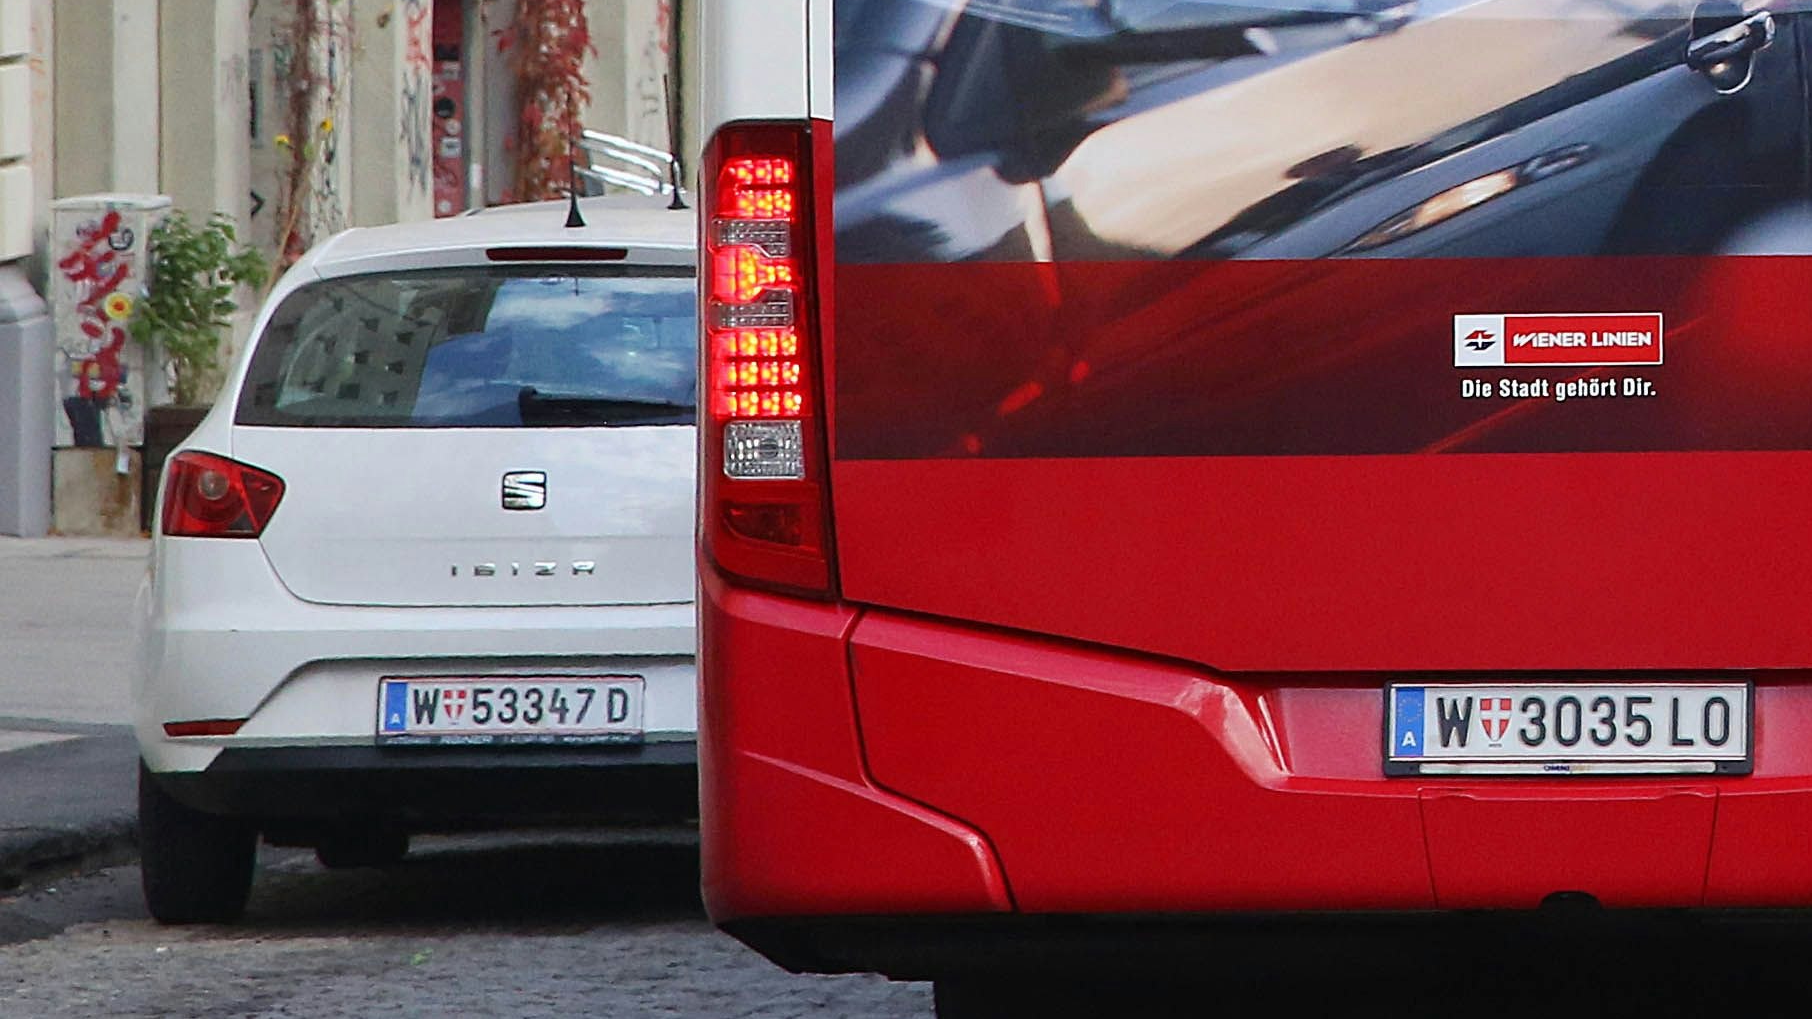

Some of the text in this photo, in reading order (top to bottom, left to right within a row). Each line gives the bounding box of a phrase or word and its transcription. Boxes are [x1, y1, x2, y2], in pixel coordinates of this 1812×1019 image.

[1513, 331, 1652, 348] WIENER LINIEN
[1462, 377, 1657, 401] Die Stadt gehört Dir.
[451, 560, 596, 577] IBIZA
[413, 688, 440, 725] W
[472, 687, 596, 725] 53347
[607, 688, 629, 724] D
[1401, 695, 1730, 749] A W 3035 LO
